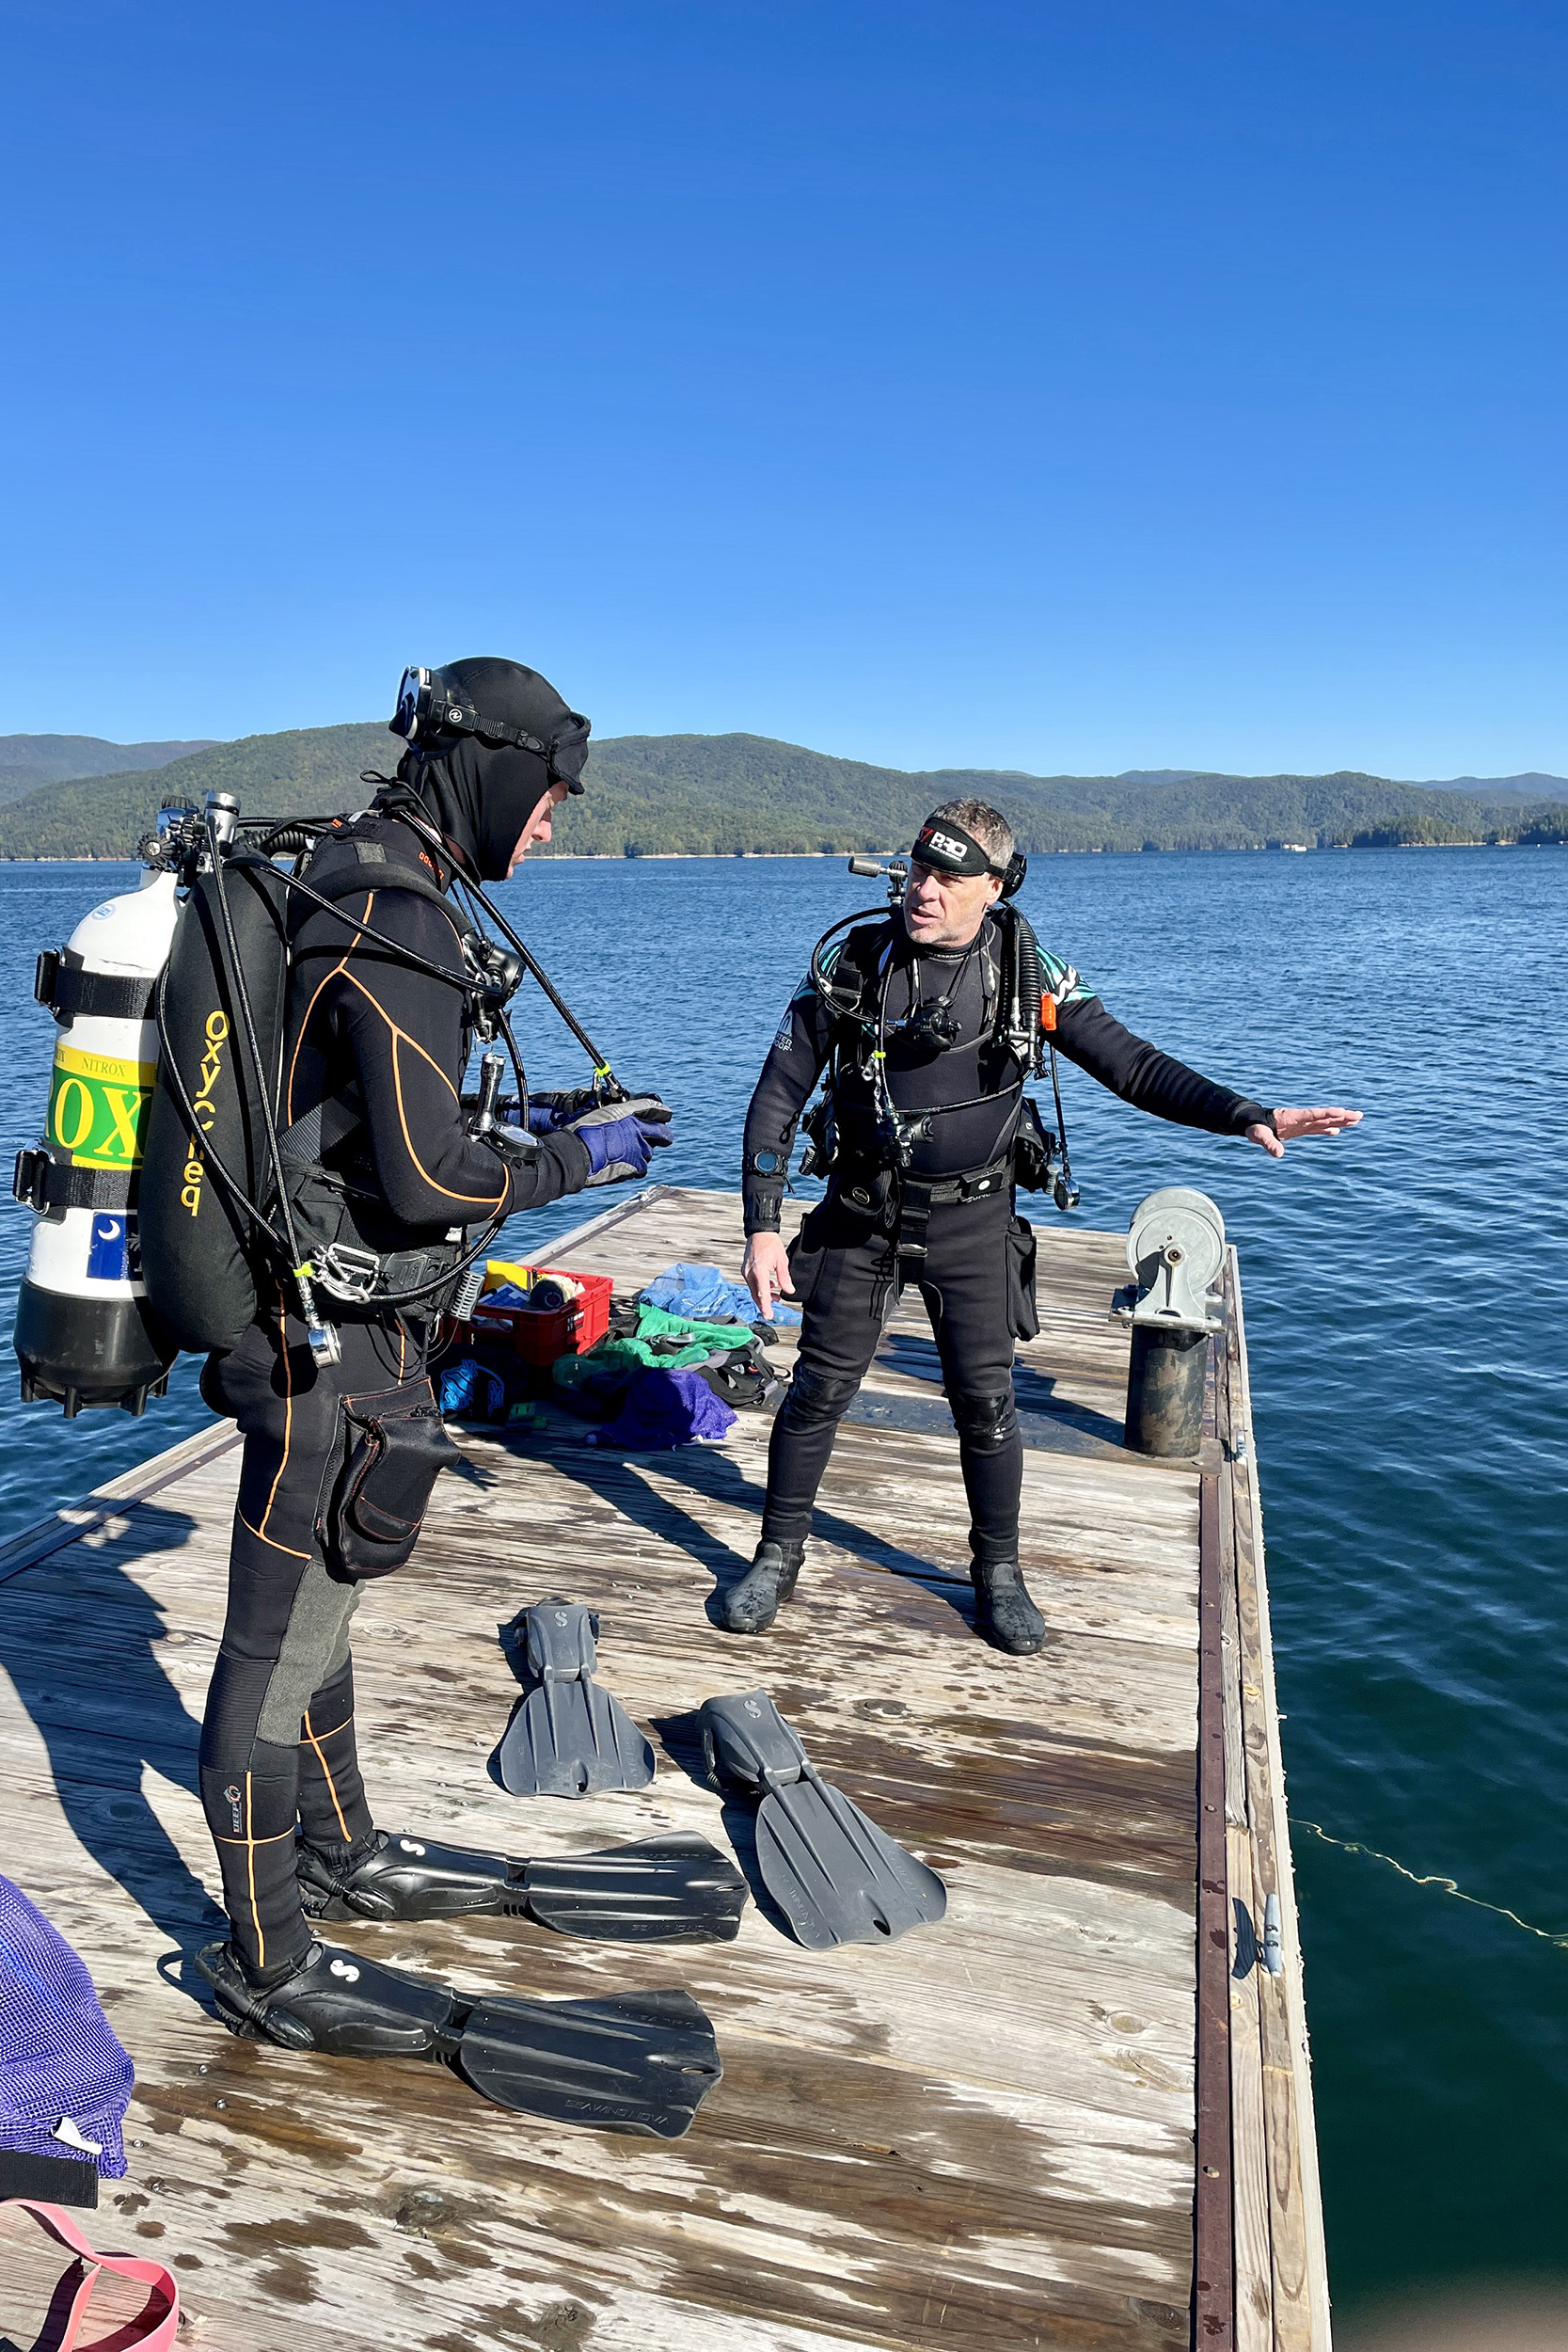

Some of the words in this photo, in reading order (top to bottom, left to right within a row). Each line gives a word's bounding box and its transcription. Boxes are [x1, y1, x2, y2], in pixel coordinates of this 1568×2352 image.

[930, 831, 968, 858] PRO
[82, 1057, 127, 1077] NITROX
[45, 1078, 152, 1159] OX
[564, 2099, 628, 2117] SEAWING
